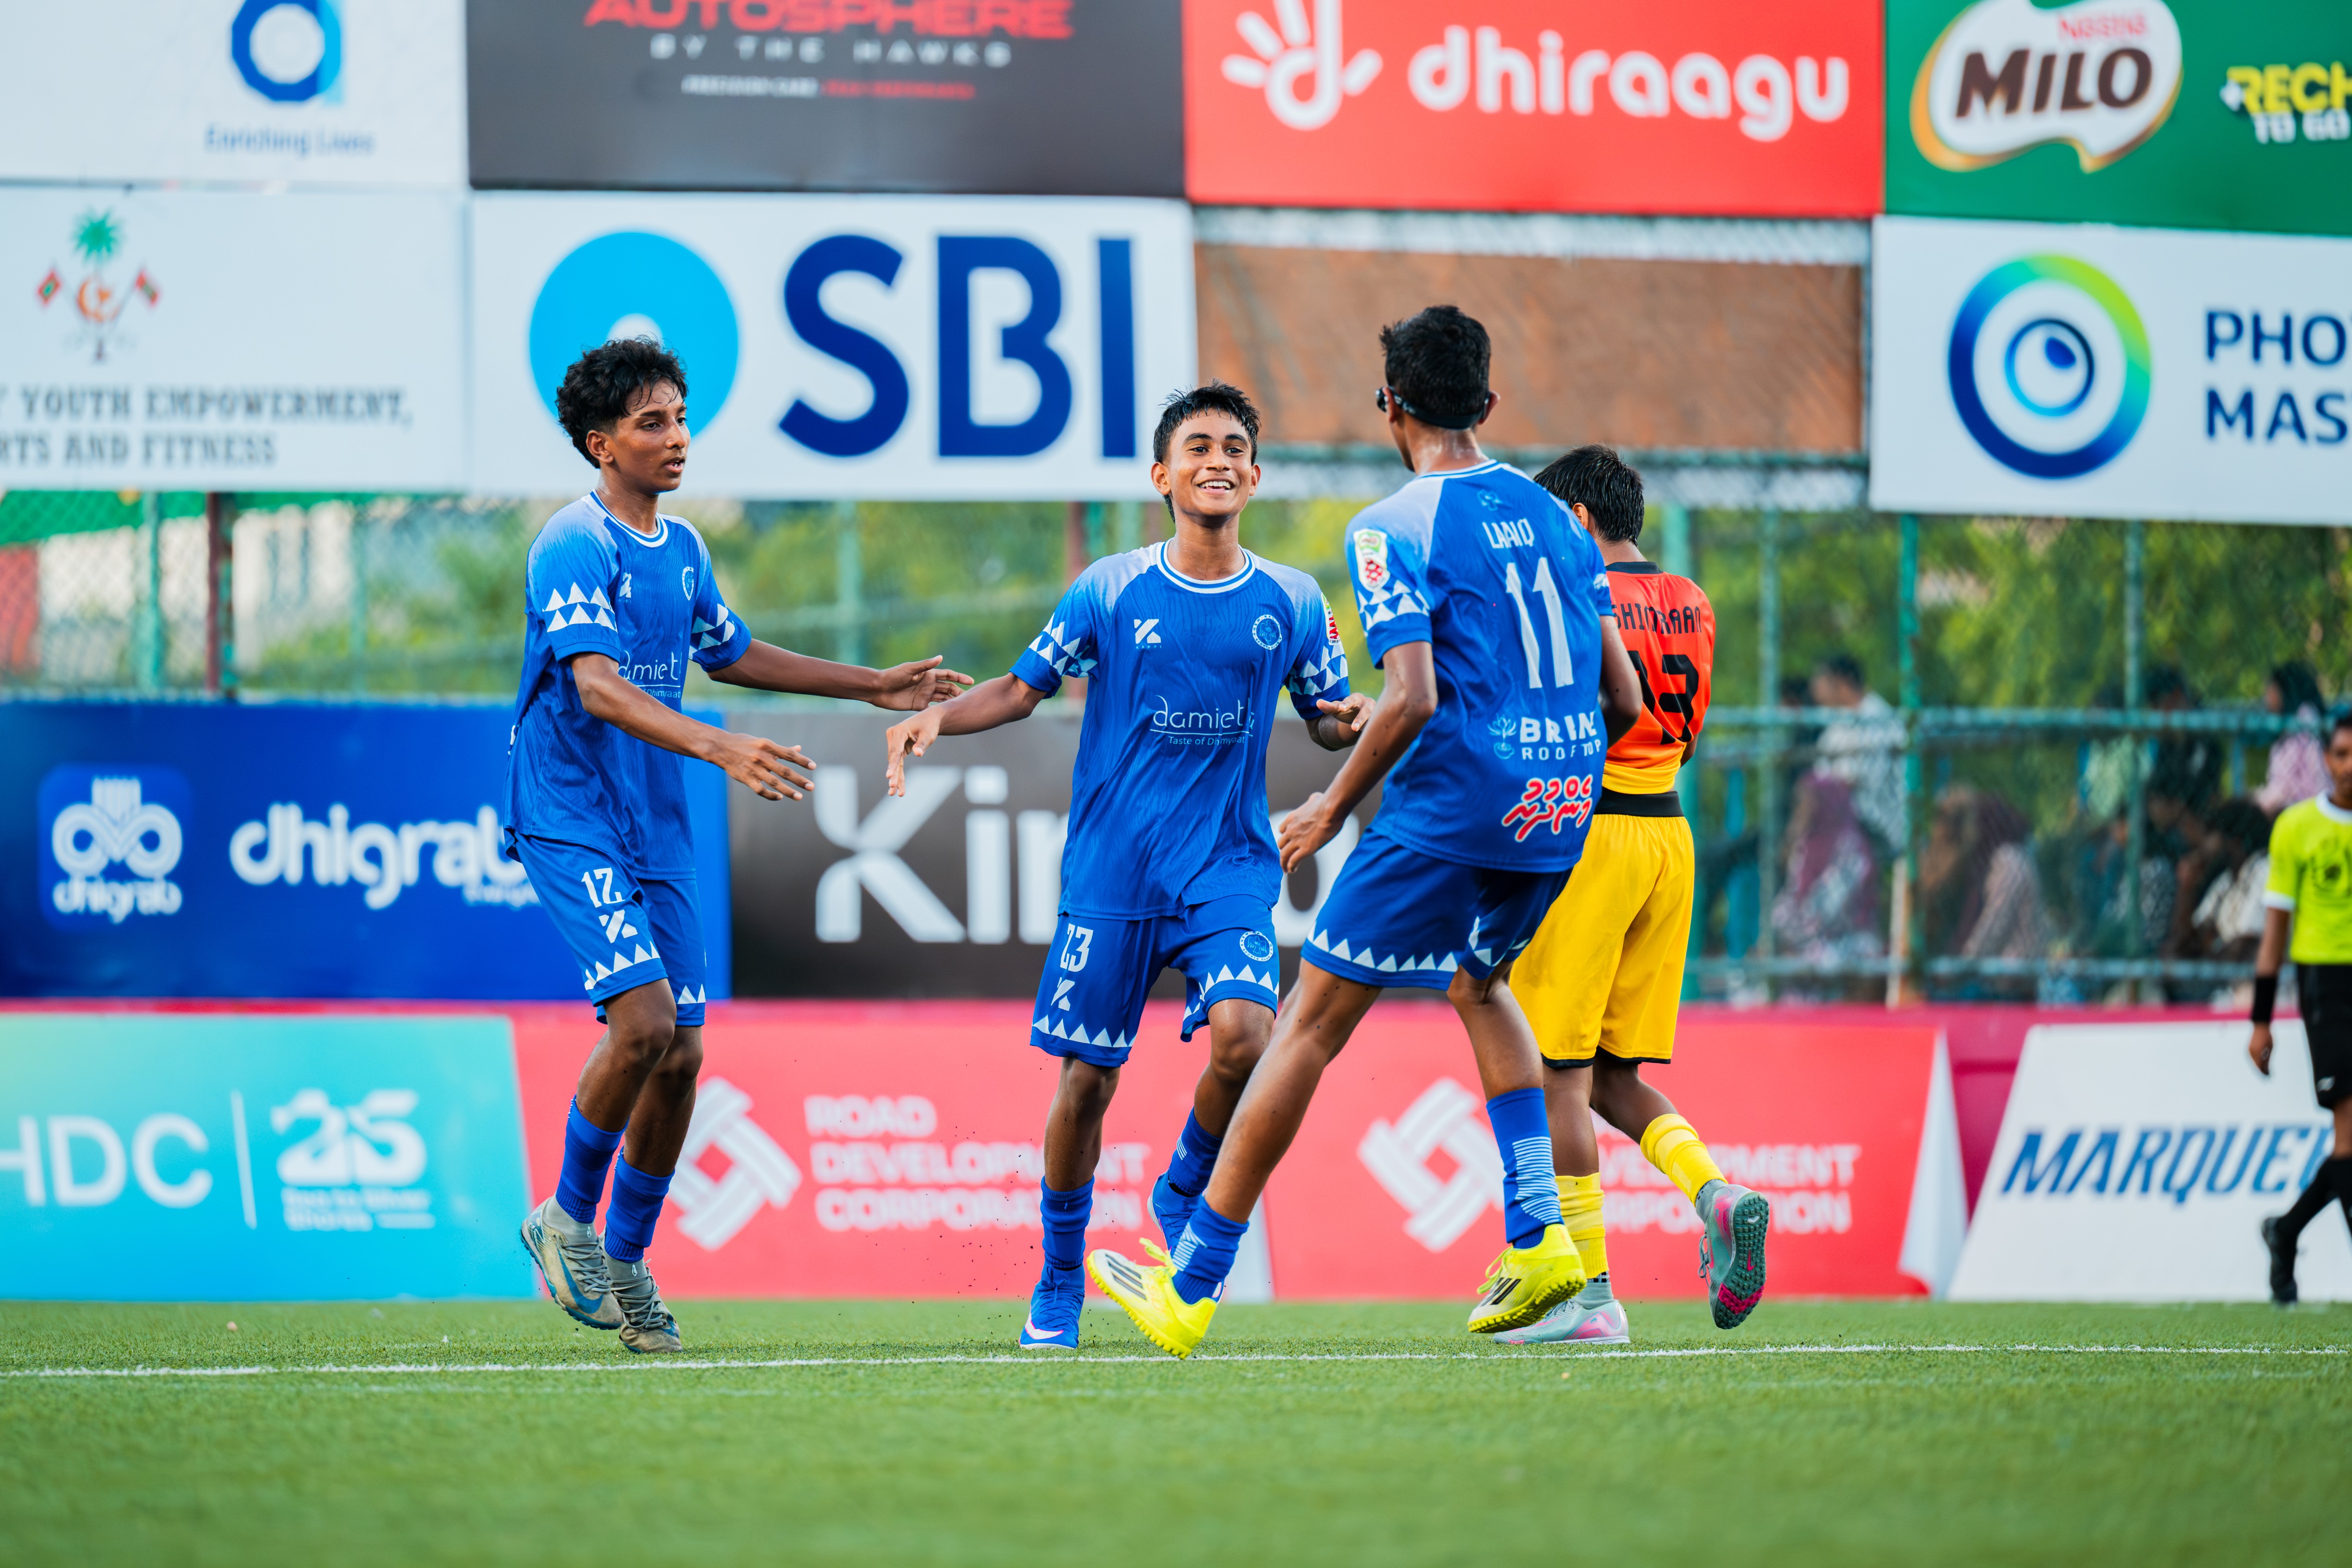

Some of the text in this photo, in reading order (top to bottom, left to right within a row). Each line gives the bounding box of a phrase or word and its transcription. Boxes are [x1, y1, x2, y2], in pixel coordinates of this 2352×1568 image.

[584, 0, 1075, 39] AUTOSPHERE
[650, 33, 706, 60] BY
[735, 34, 824, 63] THE
[1406, 24, 1850, 142] dhiraagu
[1955, 48, 2153, 118] MILO
[205, 125, 375, 156] Enriching Lives
[2253, 110, 2351, 144] TO GO
[779, 234, 1137, 457] SBI
[2205, 311, 2352, 366] PHO
[22, 387, 131, 418] YOUTH
[2206, 390, 2352, 444] MAS
[65, 434, 129, 462] AND
[143, 434, 277, 462] FITNESS
[1505, 556, 1574, 689] 11
[1168, 736, 1192, 745] Taste
[1195, 737, 1205, 745] of
[1060, 923, 1094, 972] 23
[804, 1094, 938, 1137] ROAD
